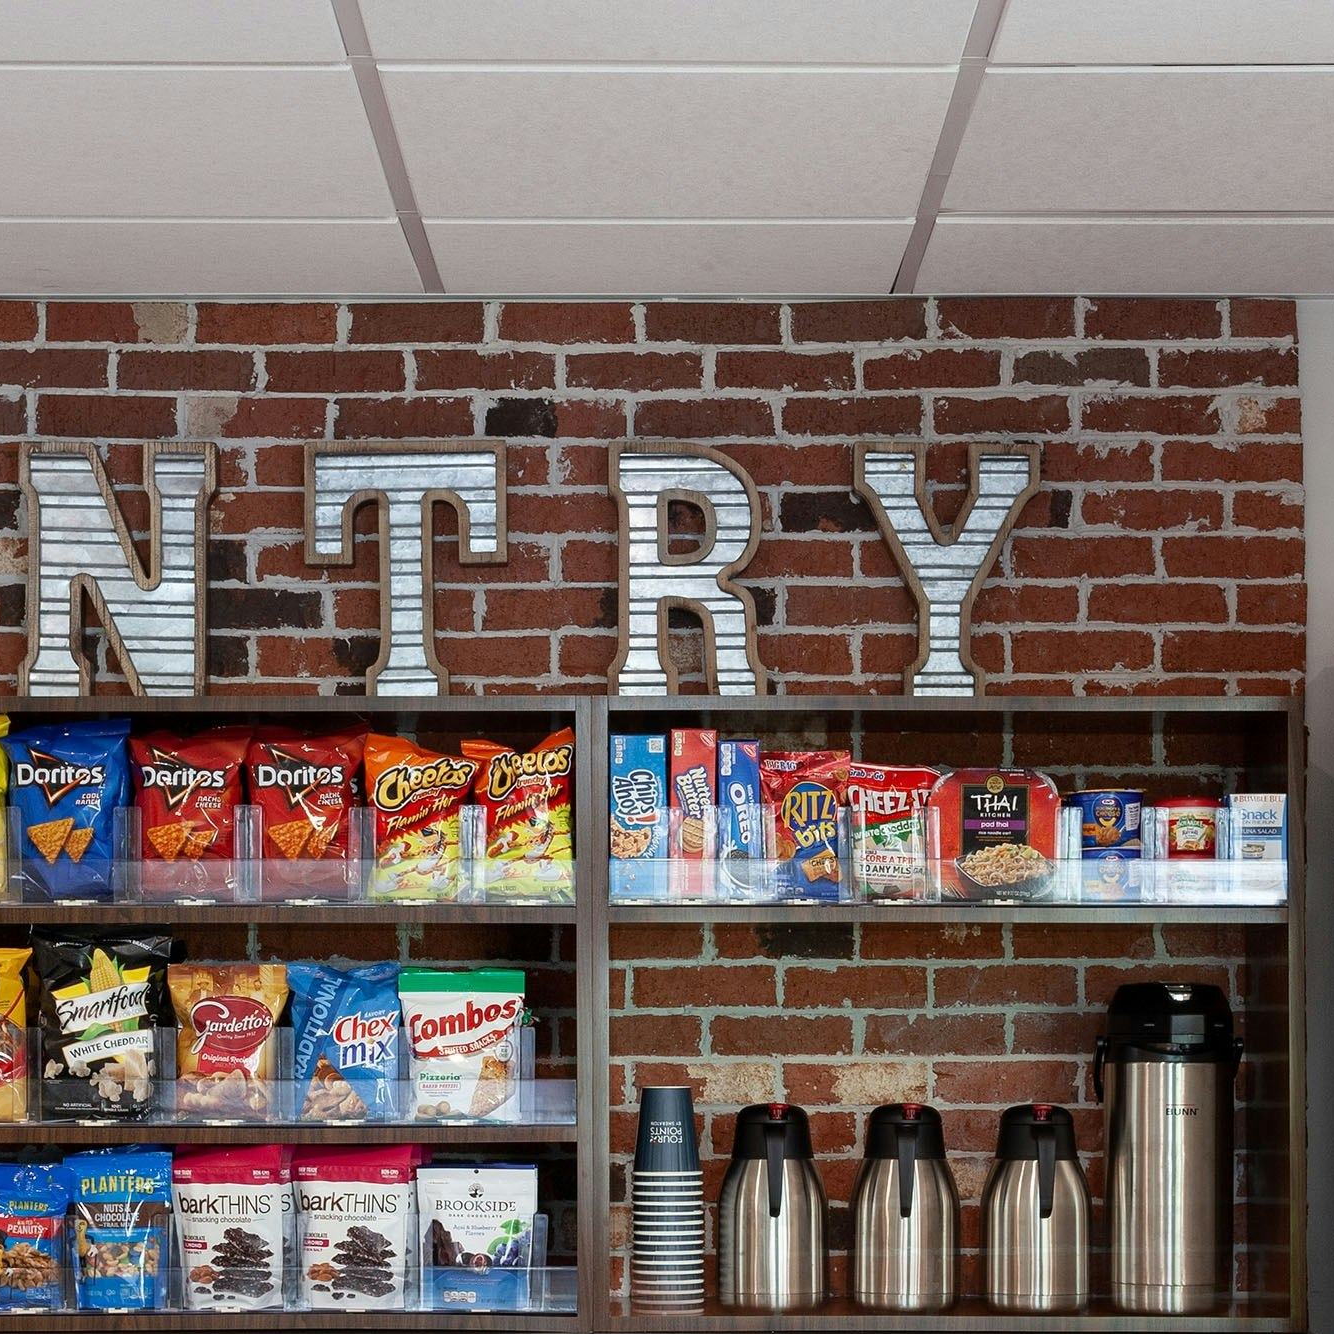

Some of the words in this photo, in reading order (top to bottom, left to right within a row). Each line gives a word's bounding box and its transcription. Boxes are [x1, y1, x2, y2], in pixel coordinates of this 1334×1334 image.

[17, 764, 104, 785] Doritos
[142, 766, 225, 787] Doritos
[258, 765, 344, 786] Doritos
[490, 747, 571, 797] Cheetos
[377, 760, 469, 807] Cheetos
[630, 770, 655, 814] Chips
[432, 793, 458, 812] Hot
[783, 790, 832, 828] RITZ
[970, 794, 1018, 813] THAI
[730, 783, 751, 844] OREO
[1242, 808, 1278, 820] Snack
[794, 822, 837, 848] bits
[980, 820, 995, 829] pad
[995, 820, 1009, 828] thai
[860, 855, 887, 863] SCORE
[871, 864, 892, 873] ANY
[892, 865, 912, 875] MLS
[56, 985, 150, 1031] Smartfood
[296, 976, 343, 1086] RADITIONAL
[335, 1010, 400, 1044] Chex
[409, 999, 517, 1045] Combos
[70, 1042, 103, 1058] WHITE
[104, 1036, 148, 1050] CHEDDAR
[419, 1073, 461, 1081] Pizzeria
[650, 1127, 683, 1136] POINTS
[657, 1135, 683, 1144] FOUR
[80, 1175, 155, 1196] PLANTERS
[8, 1200, 49, 1213] PLANTERS
[103, 1203, 124, 1213] NUTS
[178, 1191, 271, 1215] barkTHINS
[299, 1189, 398, 1213] barkTHINS
[435, 1199, 516, 1212] BROOKSIDE
[94, 1212, 140, 1222] CHOCOLATE
[192, 1217, 219, 1225] snacking
[219, 1216, 252, 1224] chocolate
[313, 1213, 343, 1222] snacking
[343, 1213, 377, 1221] chocolate
[6, 1224, 44, 1235] PEANUTS
